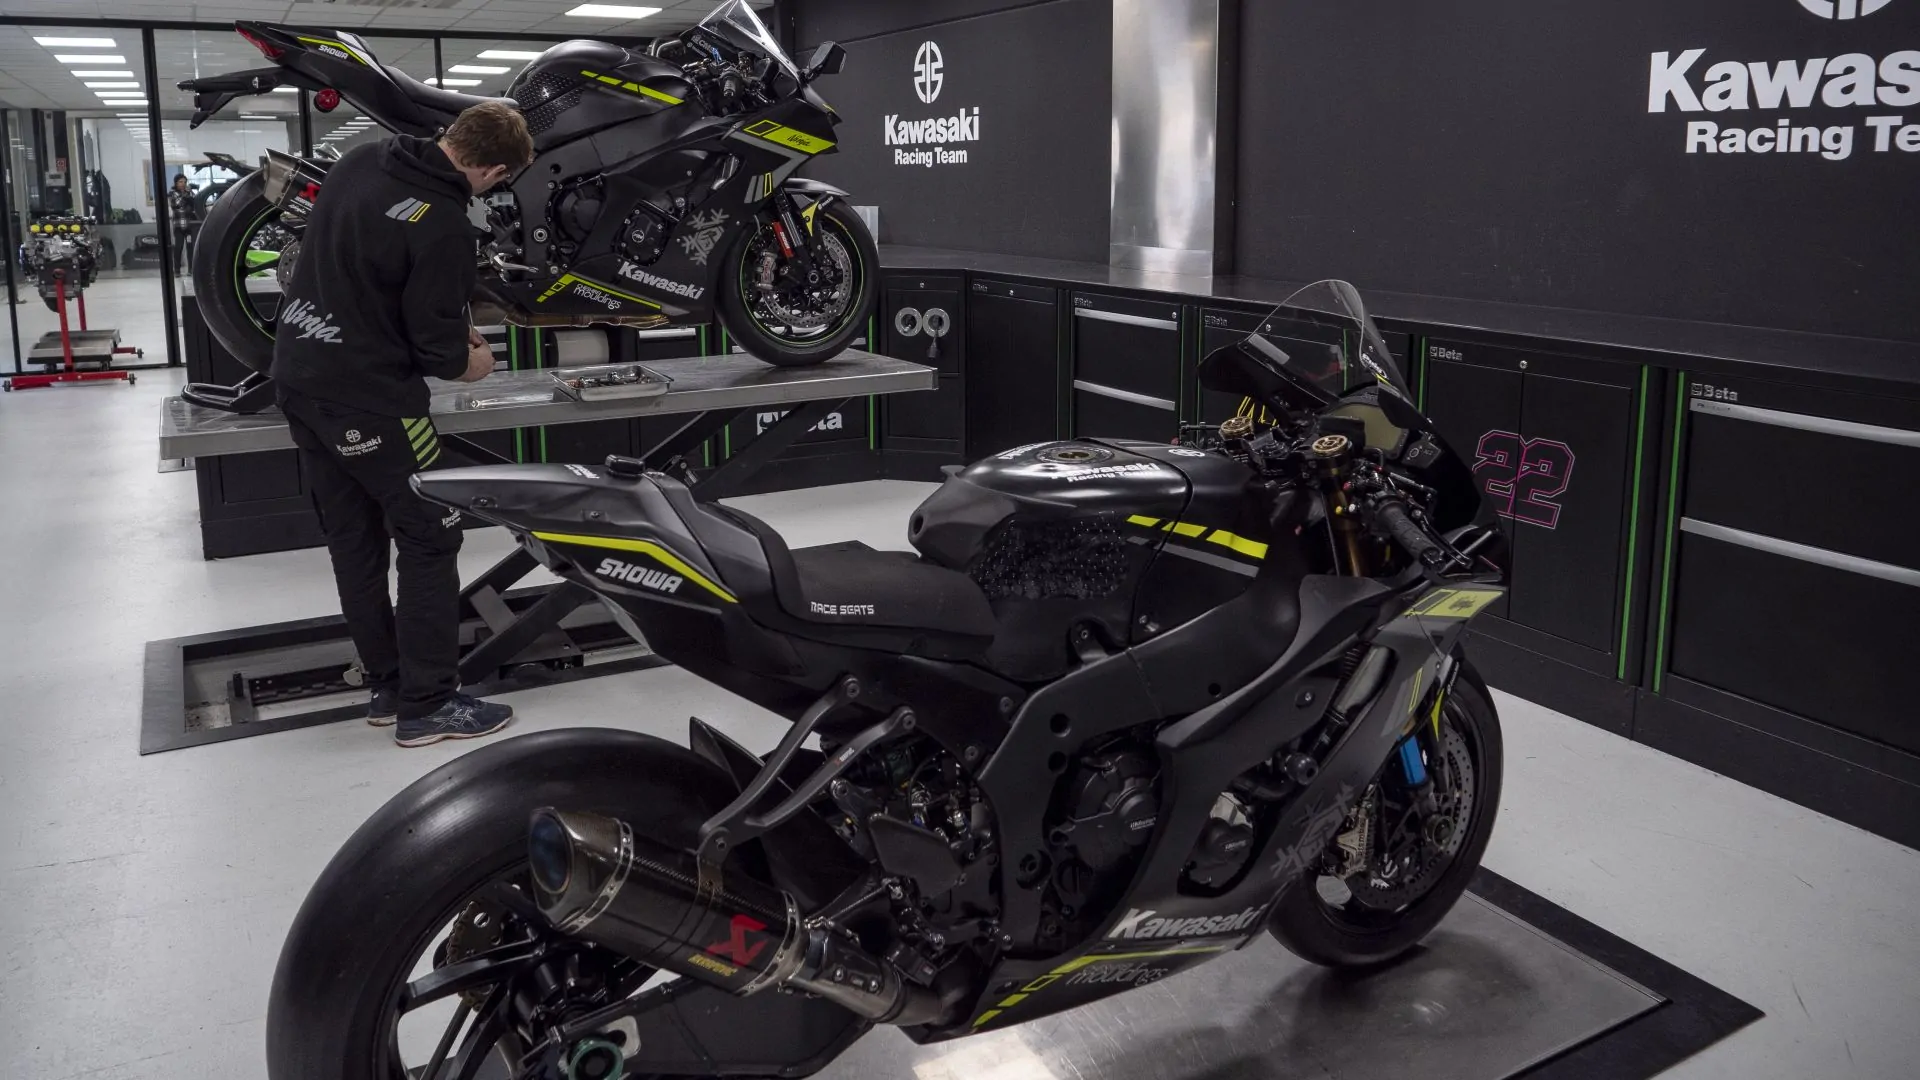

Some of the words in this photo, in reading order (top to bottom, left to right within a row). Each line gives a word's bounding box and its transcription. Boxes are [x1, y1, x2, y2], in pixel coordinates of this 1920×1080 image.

[318, 44, 349, 60] SHOWA
[884, 106, 980, 146] Kawasaki
[1685, 118, 1854, 161] Racing
[894, 147, 933, 168] Racing
[934, 146, 968, 164] Team
[573, 285, 622, 310] mouldings
[617, 260, 705, 300] Kawasaki
[281, 298, 343, 344] Ninja
[1438, 347, 1463, 361] Beta
[1703, 384, 1739, 401] Beta
[1471, 429, 1576, 530] 22
[595, 557, 683, 593] SHOWA
[810, 601, 838, 615] RACE
[839, 604, 875, 615] SEATS
[1108, 903, 1269, 939] Kawasaki
